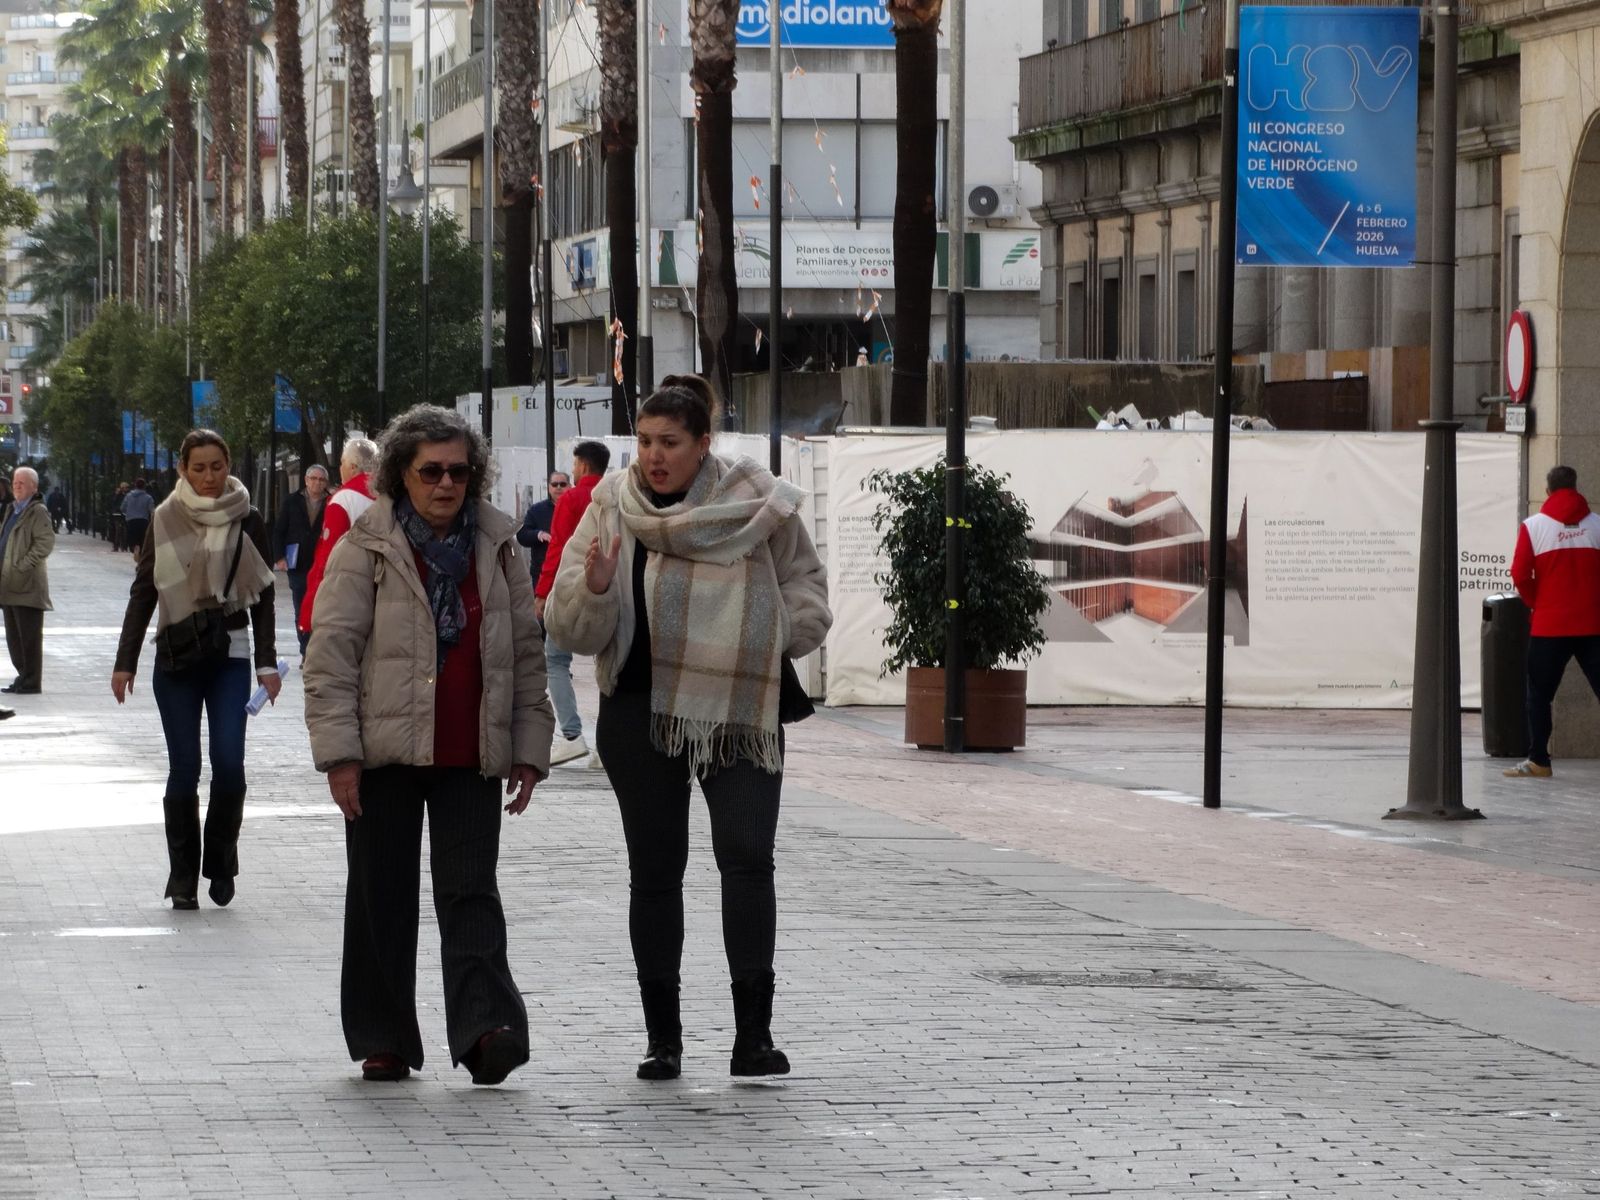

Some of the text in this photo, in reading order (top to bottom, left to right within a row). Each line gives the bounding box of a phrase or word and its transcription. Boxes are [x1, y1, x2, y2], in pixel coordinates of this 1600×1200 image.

[738, 0, 896, 25] mdiolanu
[1248, 122, 1345, 135] III CONGRESO
[1248, 140, 1323, 153] NACIONAL
[1247, 156, 1358, 172] DE HIDRÓGENO
[1246, 176, 1295, 190] VERDE
[1357, 203, 1364, 214] 4
[1374, 203, 1382, 214] 6
[1356, 217, 1408, 228] FEBRERO
[1356, 231, 1384, 242] 2026
[796, 245, 891, 254] Planes de Decesos
[1356, 245, 1399, 256] HUELVA
[796, 257, 895, 268] Familiares y Person
[1460, 551, 1506, 564] Somos
[1459, 566, 1512, 578] nuestro
[1459, 579, 1516, 592] patrimo
